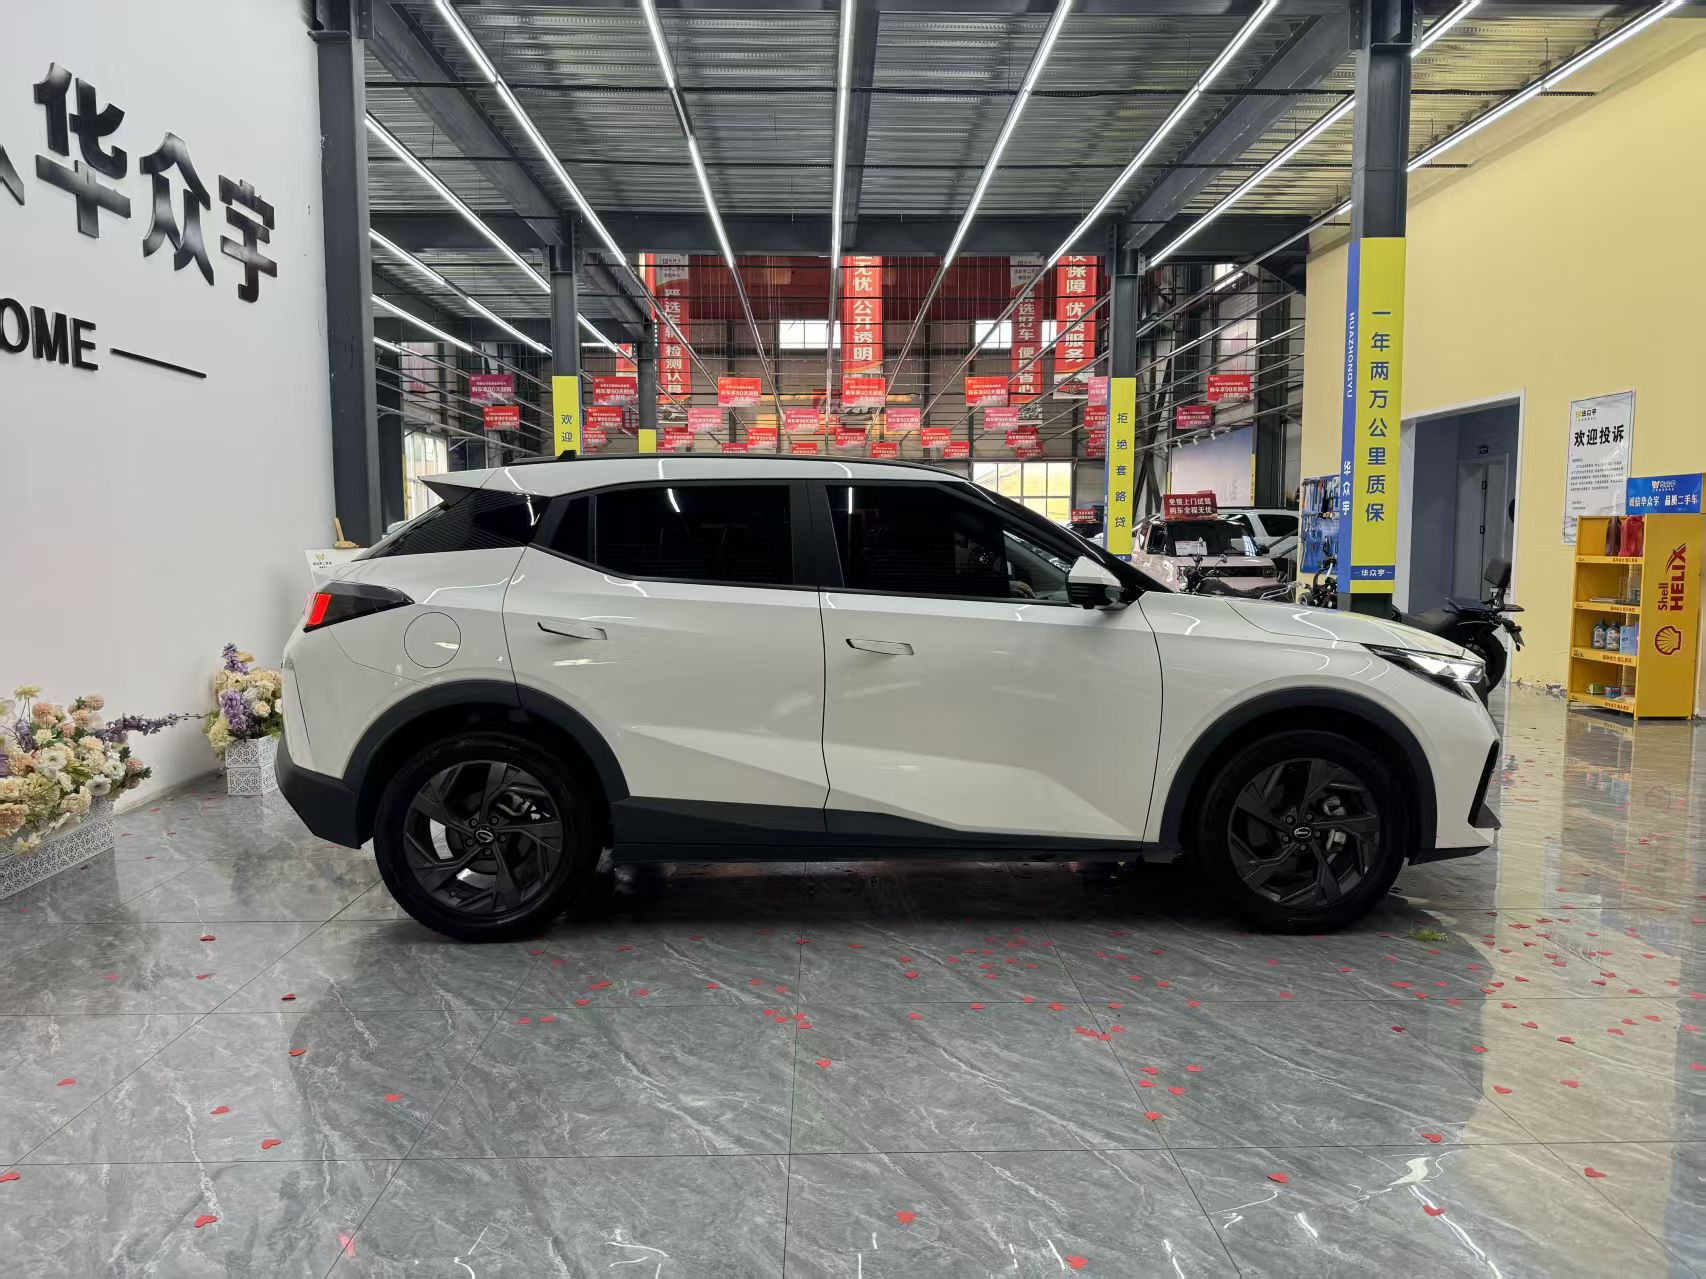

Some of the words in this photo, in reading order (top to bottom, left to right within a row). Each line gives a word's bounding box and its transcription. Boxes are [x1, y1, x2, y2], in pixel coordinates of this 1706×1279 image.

[0, 61, 278, 303] 华众宇
[853, 301, 873, 361] 公开透明
[1346, 312, 1355, 398] HUAZHONGYU
[561, 414, 573, 442] 欢迎
[1365, 311, 1392, 523] 一年两万公里质保
[1573, 424, 1625, 448] 欢迎投诉
[1114, 412, 1129, 528] 拒绝套路贷
[1342, 461, 1352, 515] 华众宇
[1664, 493, 1698, 507] 品质二手车
[1361, 569, 1386, 577] 华众宇
[1657, 582, 1669, 611] Shell
[1667, 543, 1687, 612] HELIX
